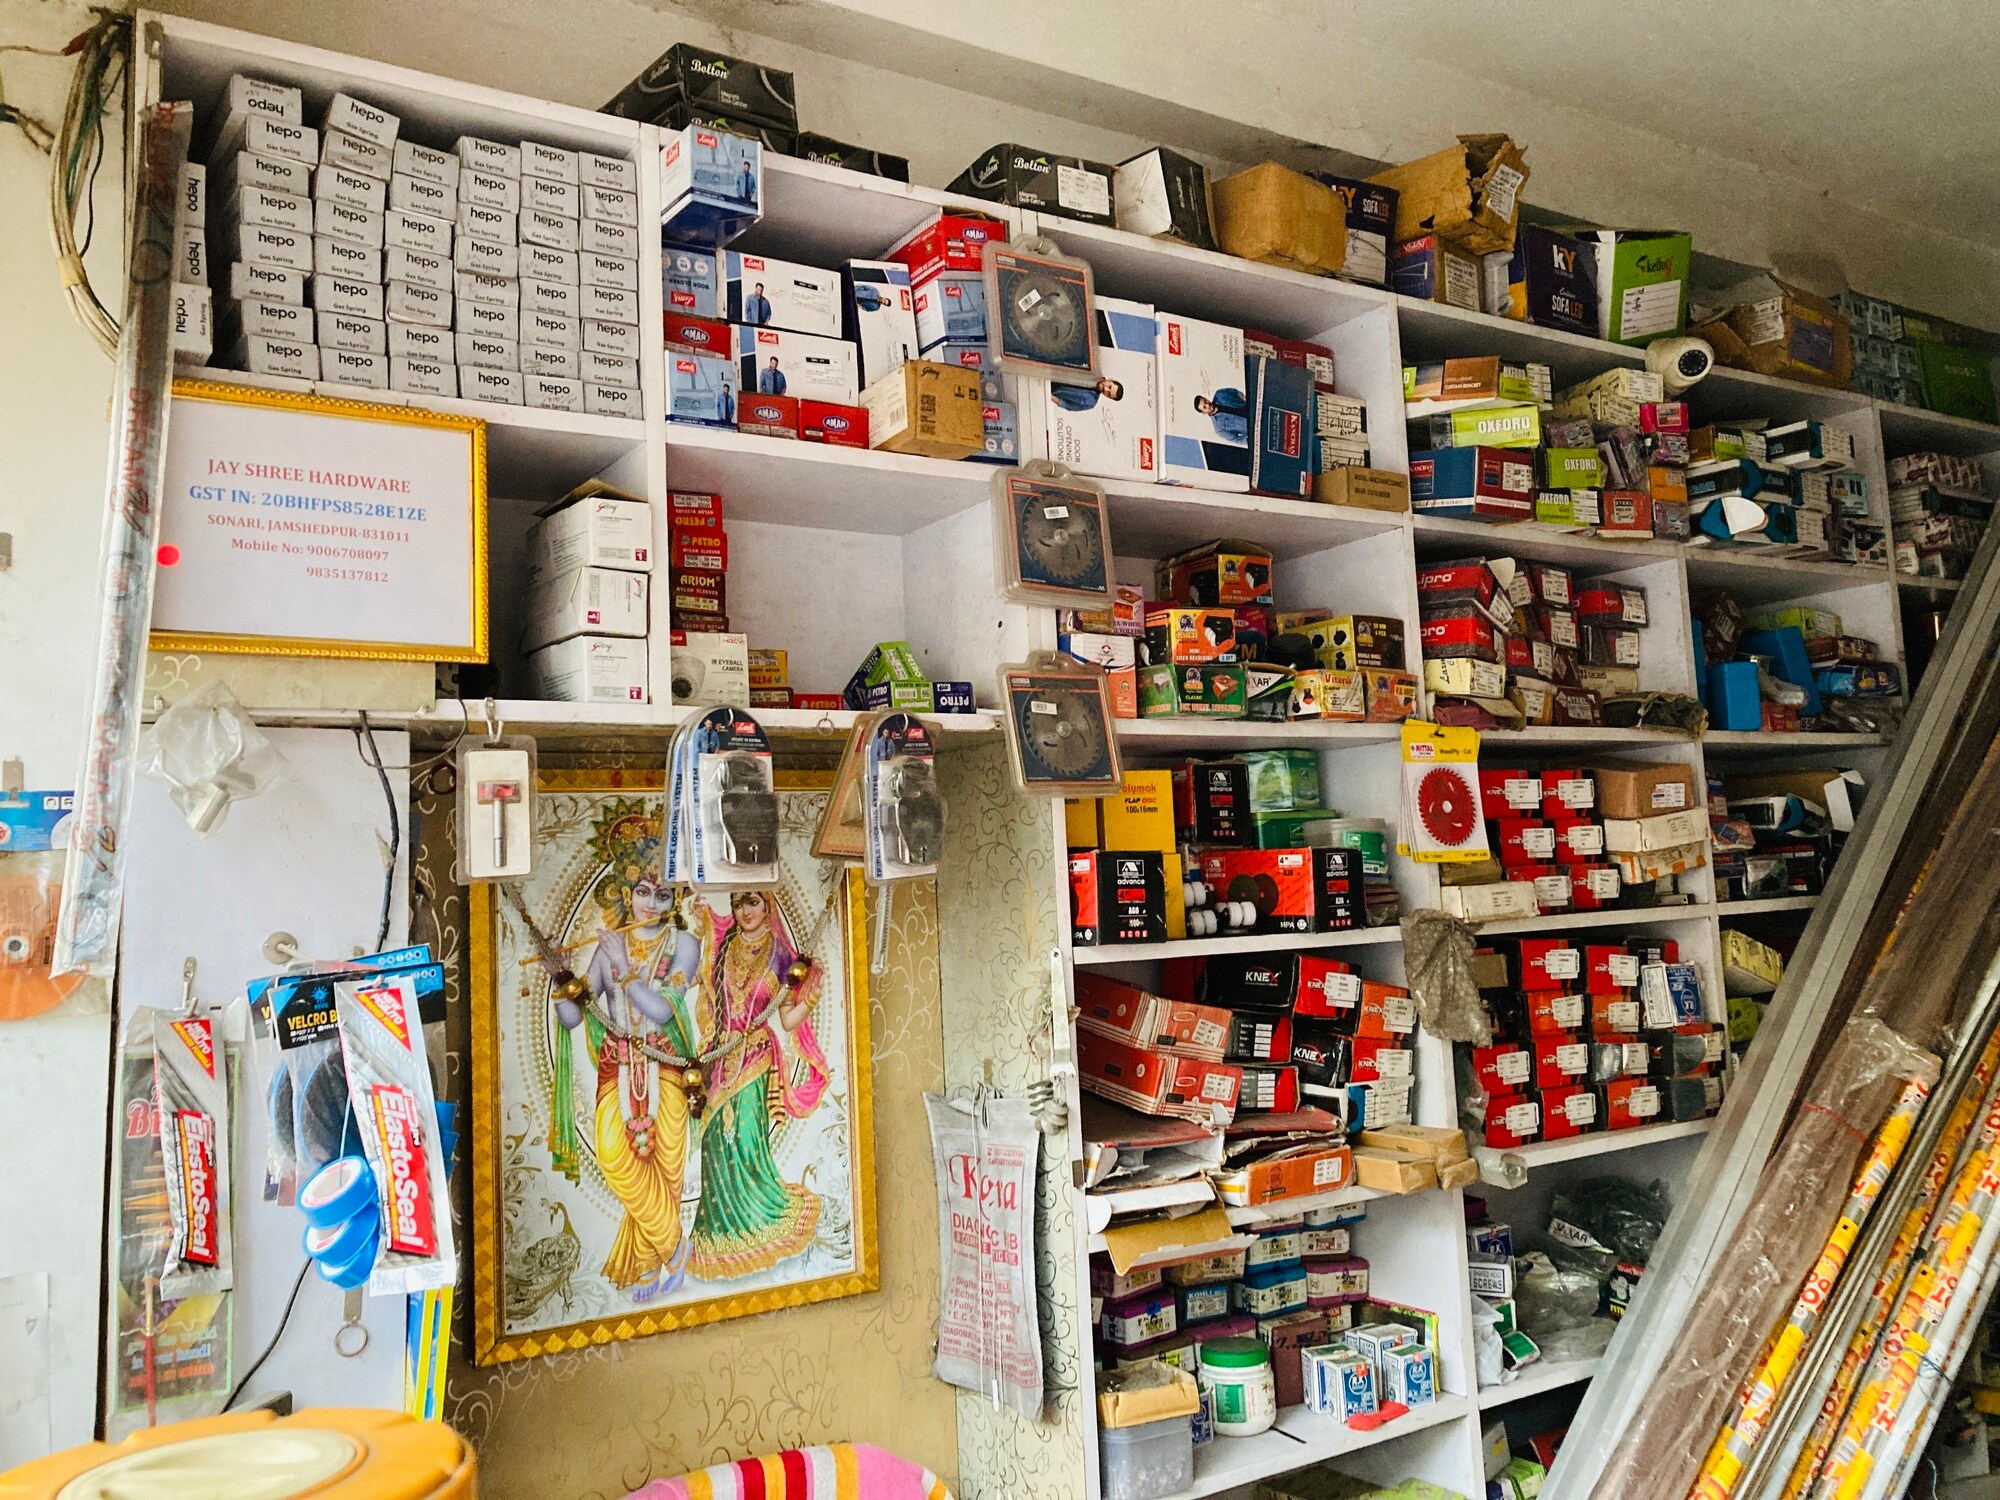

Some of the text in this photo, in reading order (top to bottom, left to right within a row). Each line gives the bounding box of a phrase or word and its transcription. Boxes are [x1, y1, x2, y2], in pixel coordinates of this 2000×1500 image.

[691, 59, 728, 79] Bolton
[248, 99, 284, 116] hepo
[350, 102, 384, 123] hepo
[266, 122, 301, 139] hepo
[343, 137, 376, 156] hepo
[475, 141, 506, 156] hepo
[535, 146, 564, 162] hepo
[412, 147, 445, 165] hepo
[256, 159, 291, 177] hepo
[594, 158, 623, 172] hepo
[1014, 157, 1050, 174] Bolton
[336, 172, 370, 191] hepo
[410, 181, 443, 198] hepo
[474, 175, 505, 191] hepo
[535, 180, 565, 196] hepo
[188, 177, 200, 212] hepo
[260, 194, 296, 210] hepo
[595, 189, 623, 203] hepo
[333, 205, 367, 223] hepo
[470, 207, 502, 223] hepo
[533, 213, 563, 229] hepo
[402, 217, 435, 234] hepo
[595, 223, 624, 238] hepo
[258, 231, 294, 247] hepo
[331, 244, 366, 261] hepo
[471, 241, 503, 256] hepo
[533, 249, 563, 264] hepo
[188, 241, 201, 276] hepo
[273, 255, 293, 264] Spring
[406, 252, 439, 269] hepo
[595, 257, 624, 272] hepo
[250, 267, 286, 282] hepo
[475, 276, 506, 288] hepo
[333, 281, 367, 297] hepo
[405, 284, 438, 301] hepo
[536, 285, 566, 300] hepo
[594, 288, 623, 302] hepo
[260, 304, 297, 320] hepo
[347, 305, 366, 313] Spring
[1552, 295, 1570, 315] SOFA
[473, 307, 504, 321] hepo
[336, 319, 370, 333] hepo
[536, 316, 566, 331] hepo
[597, 322, 626, 336] hepo
[406, 329, 439, 344] hepo
[267, 343, 302, 357] hepo
[472, 340, 504, 355] hepo
[339, 353, 372, 367] hepo
[535, 351, 565, 364] hepo
[593, 355, 623, 367] hepo
[407, 361, 441, 375] hepo
[421, 383, 439, 391] Spring
[478, 372, 509, 386] hepo
[539, 382, 570, 395] hepo
[597, 387, 628, 400] hepo
[1477, 416, 1531, 434] OXFORD
[1564, 458, 1597, 471] OXFORD
[208, 459, 411, 493] JAY SHREE HARDWARE
[189, 485, 426, 521] GST IN: 20BHFPS8528E1ZE
[1539, 492, 1570, 506] OXFORD
[207, 514, 409, 542] SONARI, JAMSHEDPUR-831011
[232, 539, 389, 561] Mobile No: 9006708097
[691, 537, 721, 547] PETRO
[306, 566, 389, 582] 9835137812
[681, 575, 715, 585] ARIOM
[940, 696, 969, 706] PETRO
[668, 773, 683, 879] TRIPLE LOCKING SYSTEM
[1246, 971, 1279, 982] KNEX
[287, 1011, 326, 1031] VELCRO
[1294, 1046, 1327, 1064] KNEX
[379, 1089, 424, 1248] ElastoSeal
[183, 1113, 210, 1257] ElastoSeal
[1473, 1278, 1502, 1289] SCREWS
